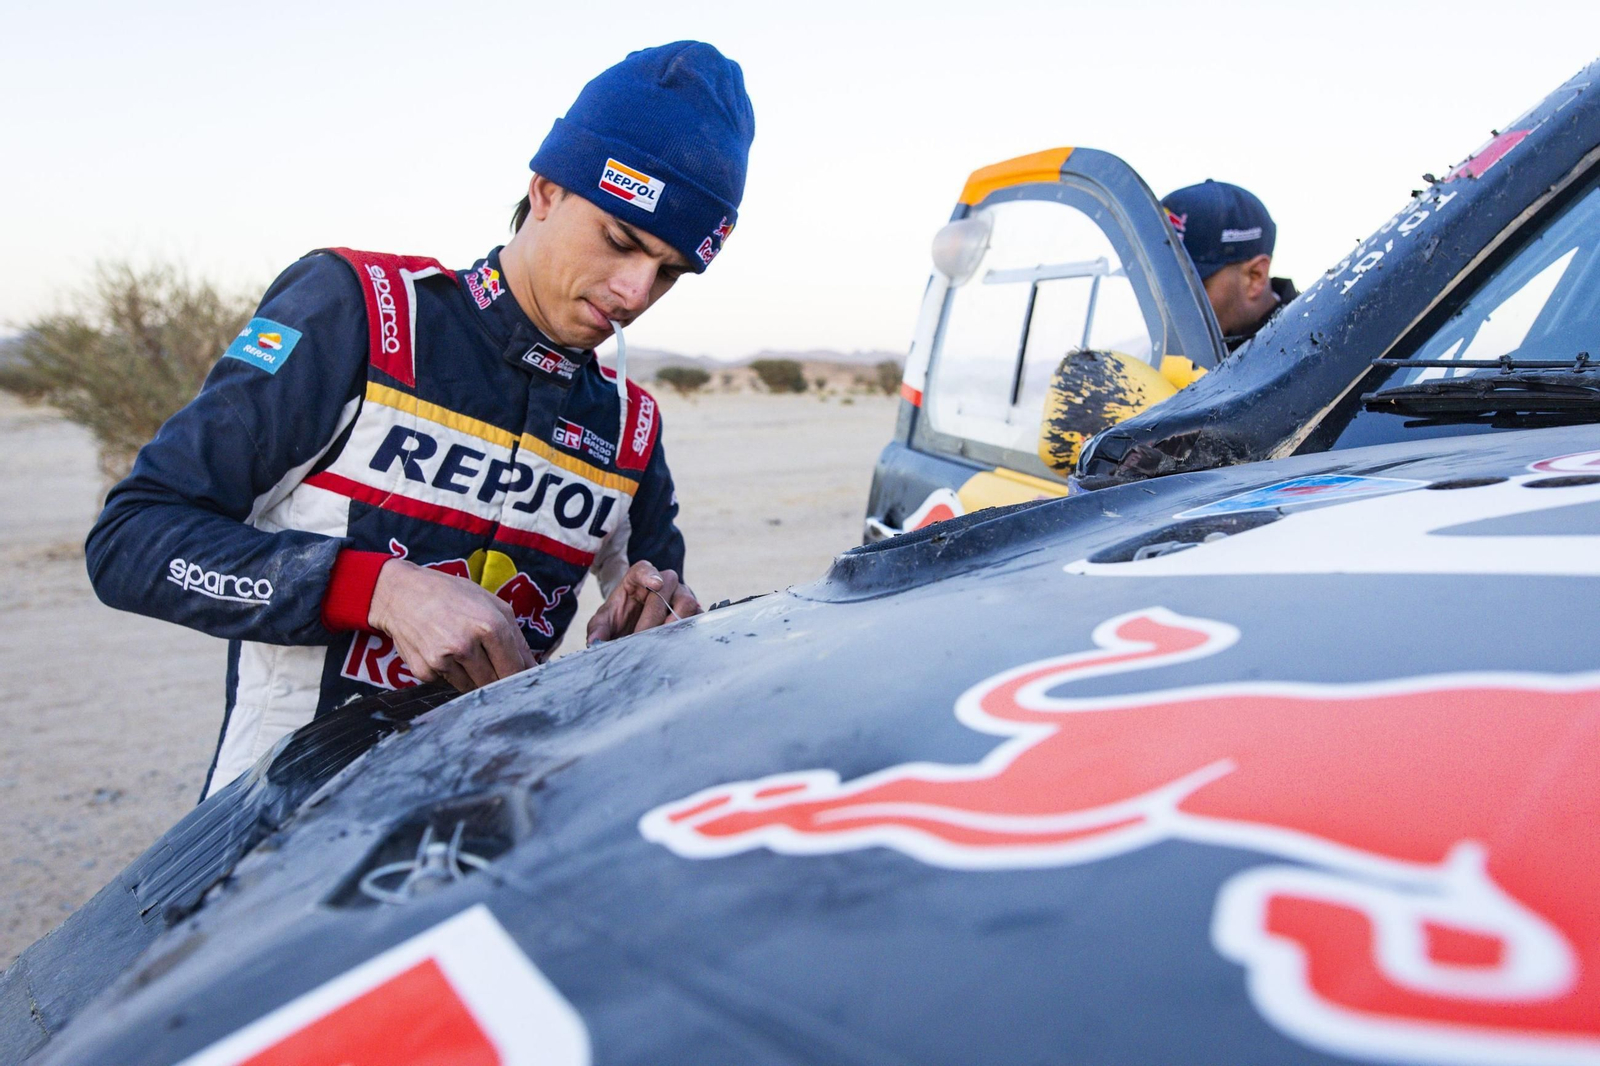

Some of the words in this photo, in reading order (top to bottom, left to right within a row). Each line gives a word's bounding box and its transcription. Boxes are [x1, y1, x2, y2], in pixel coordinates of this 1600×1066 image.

[604, 169, 655, 200] REPSOL
[465, 272, 483, 292] Red
[366, 264, 400, 354] sparco
[472, 286, 491, 310] Bull
[243, 344, 276, 364] REPSOL
[526, 352, 556, 370] GR
[554, 427, 579, 448] GR
[632, 395, 654, 456] sparco
[585, 429, 615, 451] TOYOTA
[369, 425, 616, 538] REPSOL
[168, 558, 274, 602] sparco
[341, 629, 420, 690] Re
